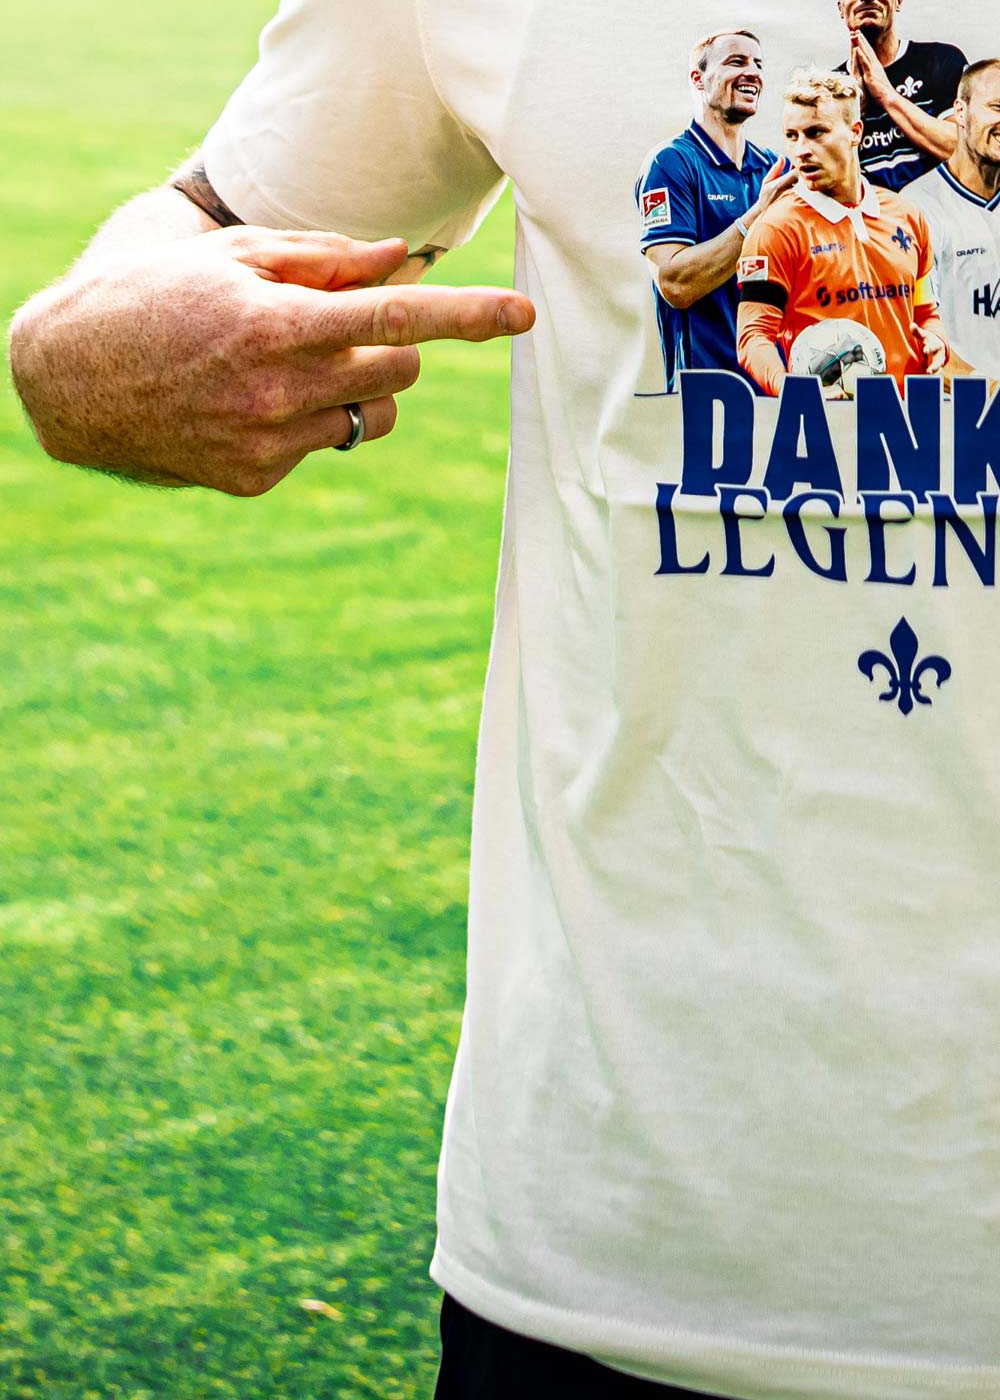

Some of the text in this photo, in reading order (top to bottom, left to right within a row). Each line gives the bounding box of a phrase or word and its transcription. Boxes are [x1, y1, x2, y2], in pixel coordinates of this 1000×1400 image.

[707, 193, 729, 202] CRAFT
[956, 247, 980, 257] CRAFT
[836, 281, 910, 305] software
